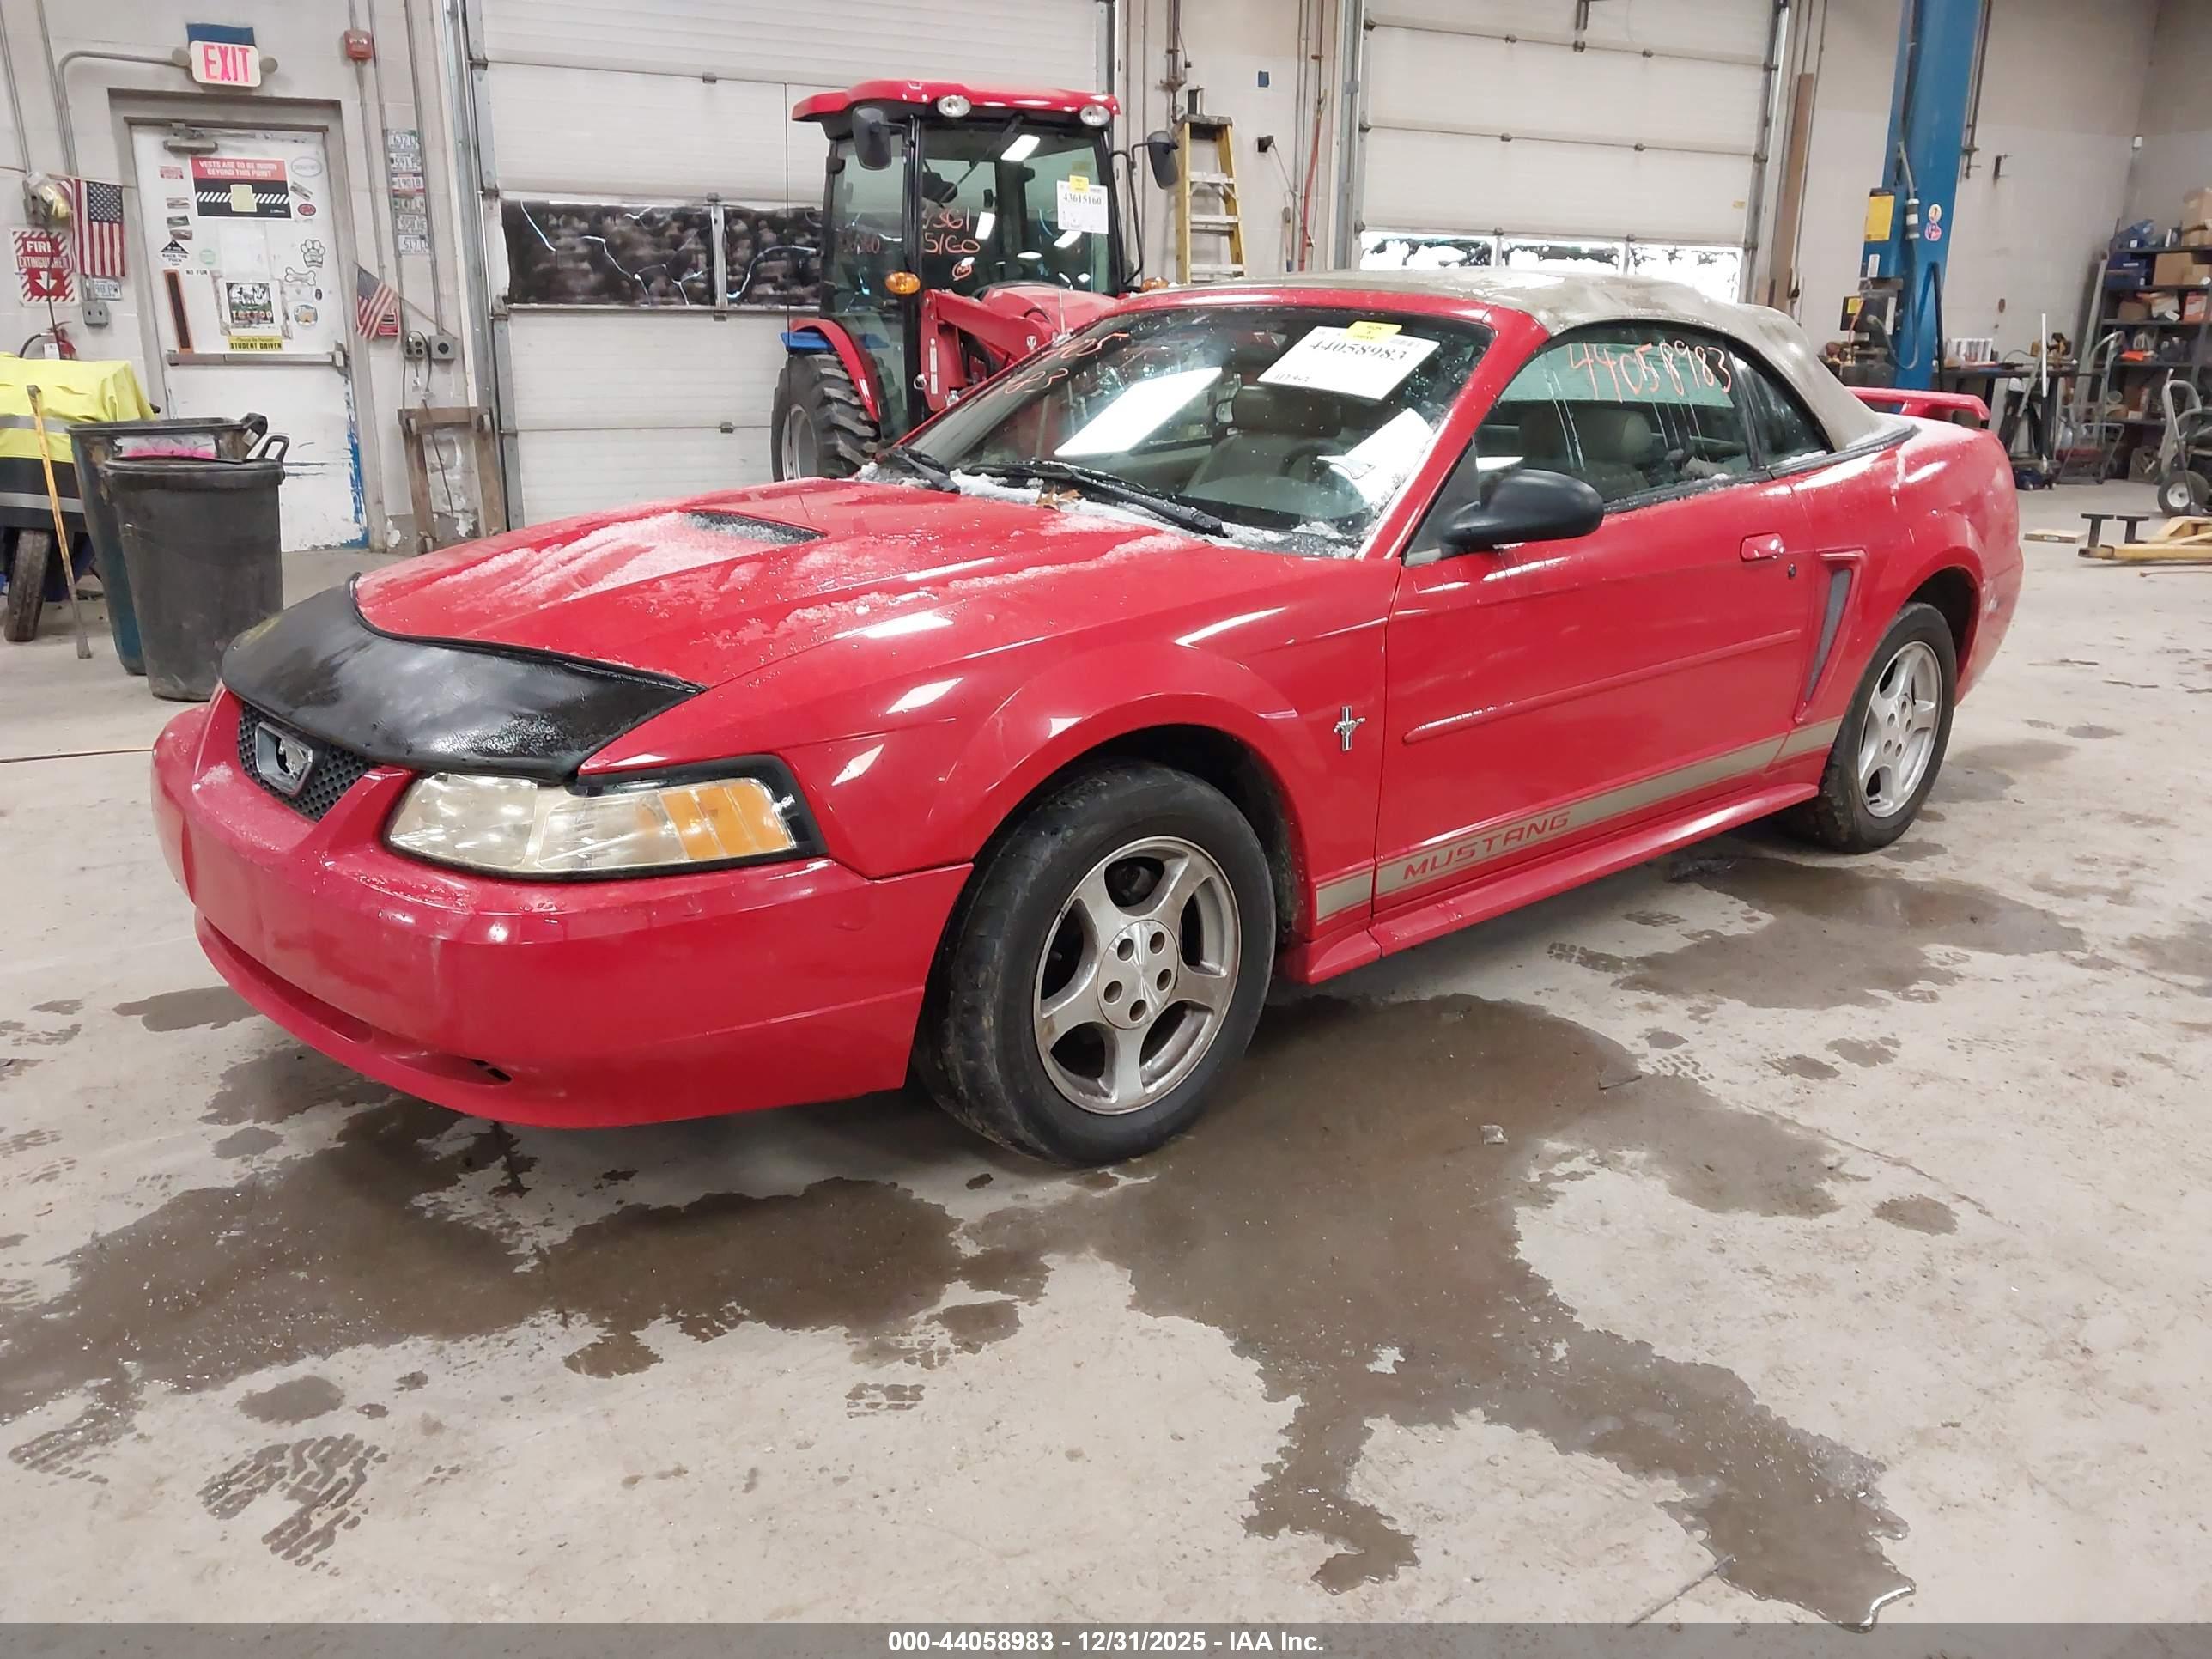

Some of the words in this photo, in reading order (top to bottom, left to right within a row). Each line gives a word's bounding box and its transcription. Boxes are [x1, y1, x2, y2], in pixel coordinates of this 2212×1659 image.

[203, 45, 250, 82] EXIT
[1309, 340, 1407, 361] 44058983
[1568, 339, 1732, 404] 44058983
[1403, 811, 1571, 880] MUSTANG
